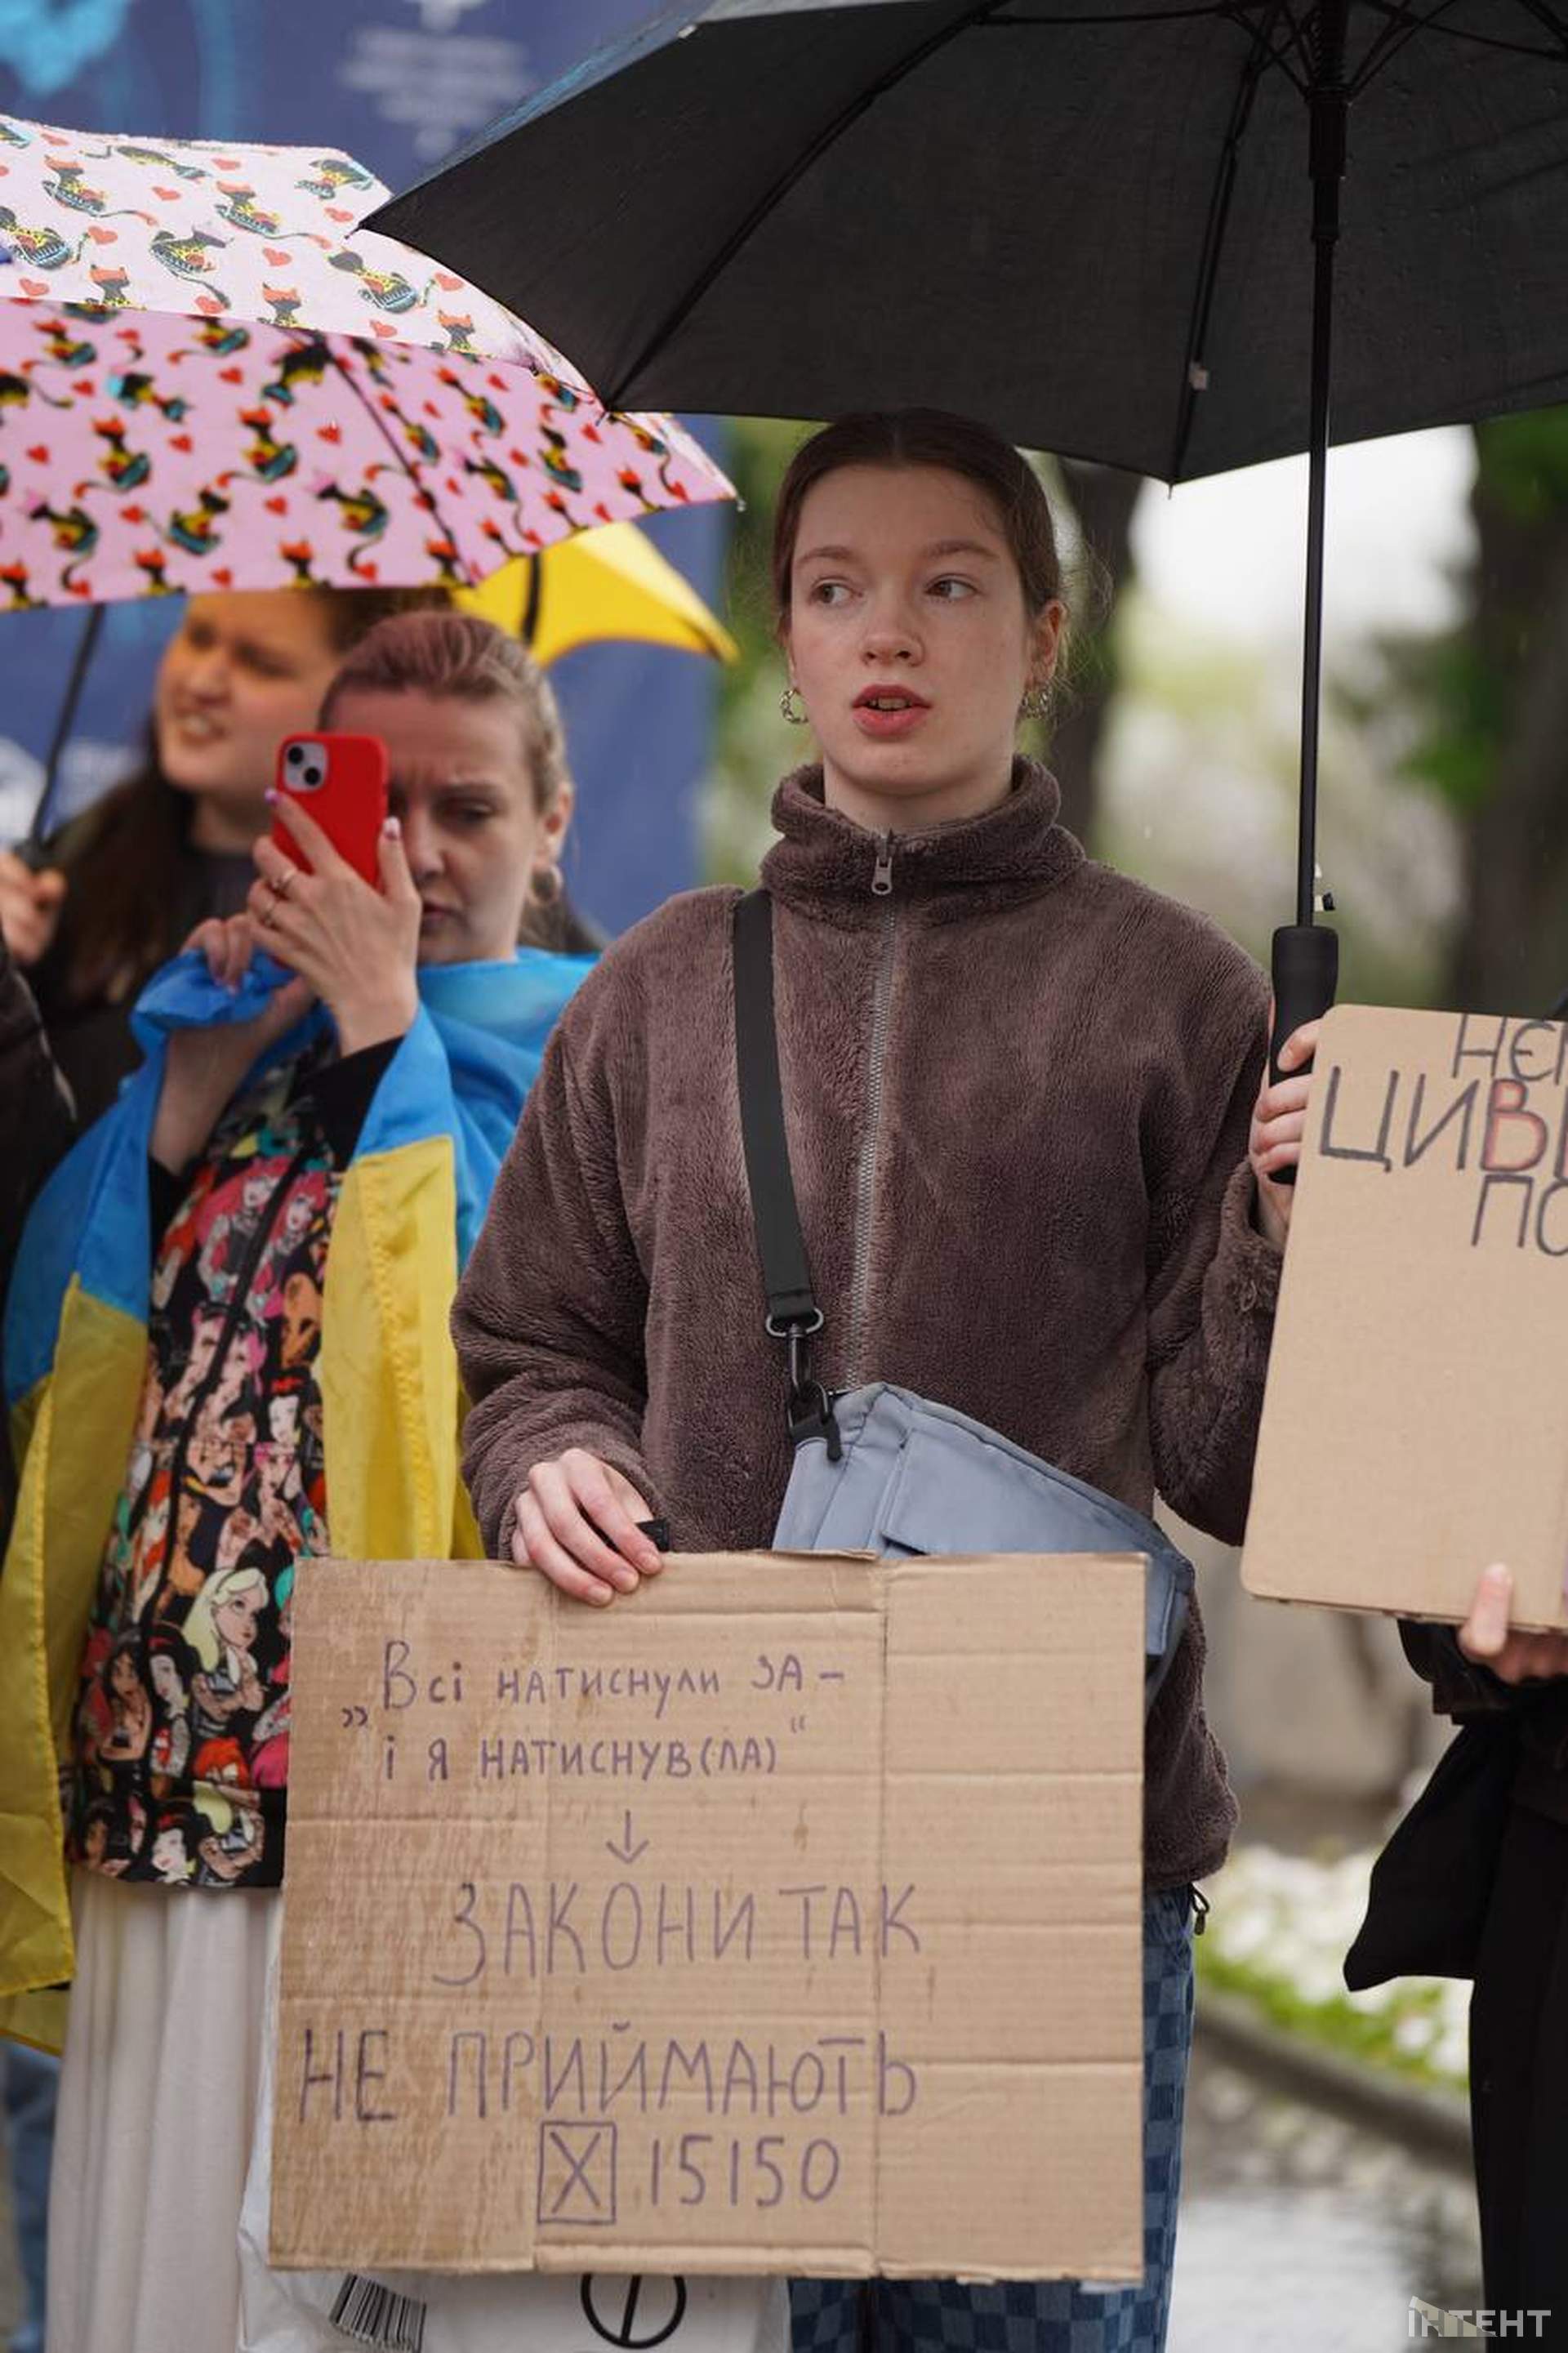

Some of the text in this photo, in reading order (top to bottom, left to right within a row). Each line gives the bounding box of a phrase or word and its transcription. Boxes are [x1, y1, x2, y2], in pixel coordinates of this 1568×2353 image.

[1320, 1064, 1568, 1179] ЦИВ
[433, 1882, 921, 1985] ЗАКОНИ ТАК
[299, 2021, 918, 2123] НЕ ПРИЙМАЮТЬ
[652, 2132, 840, 2208] 15150
